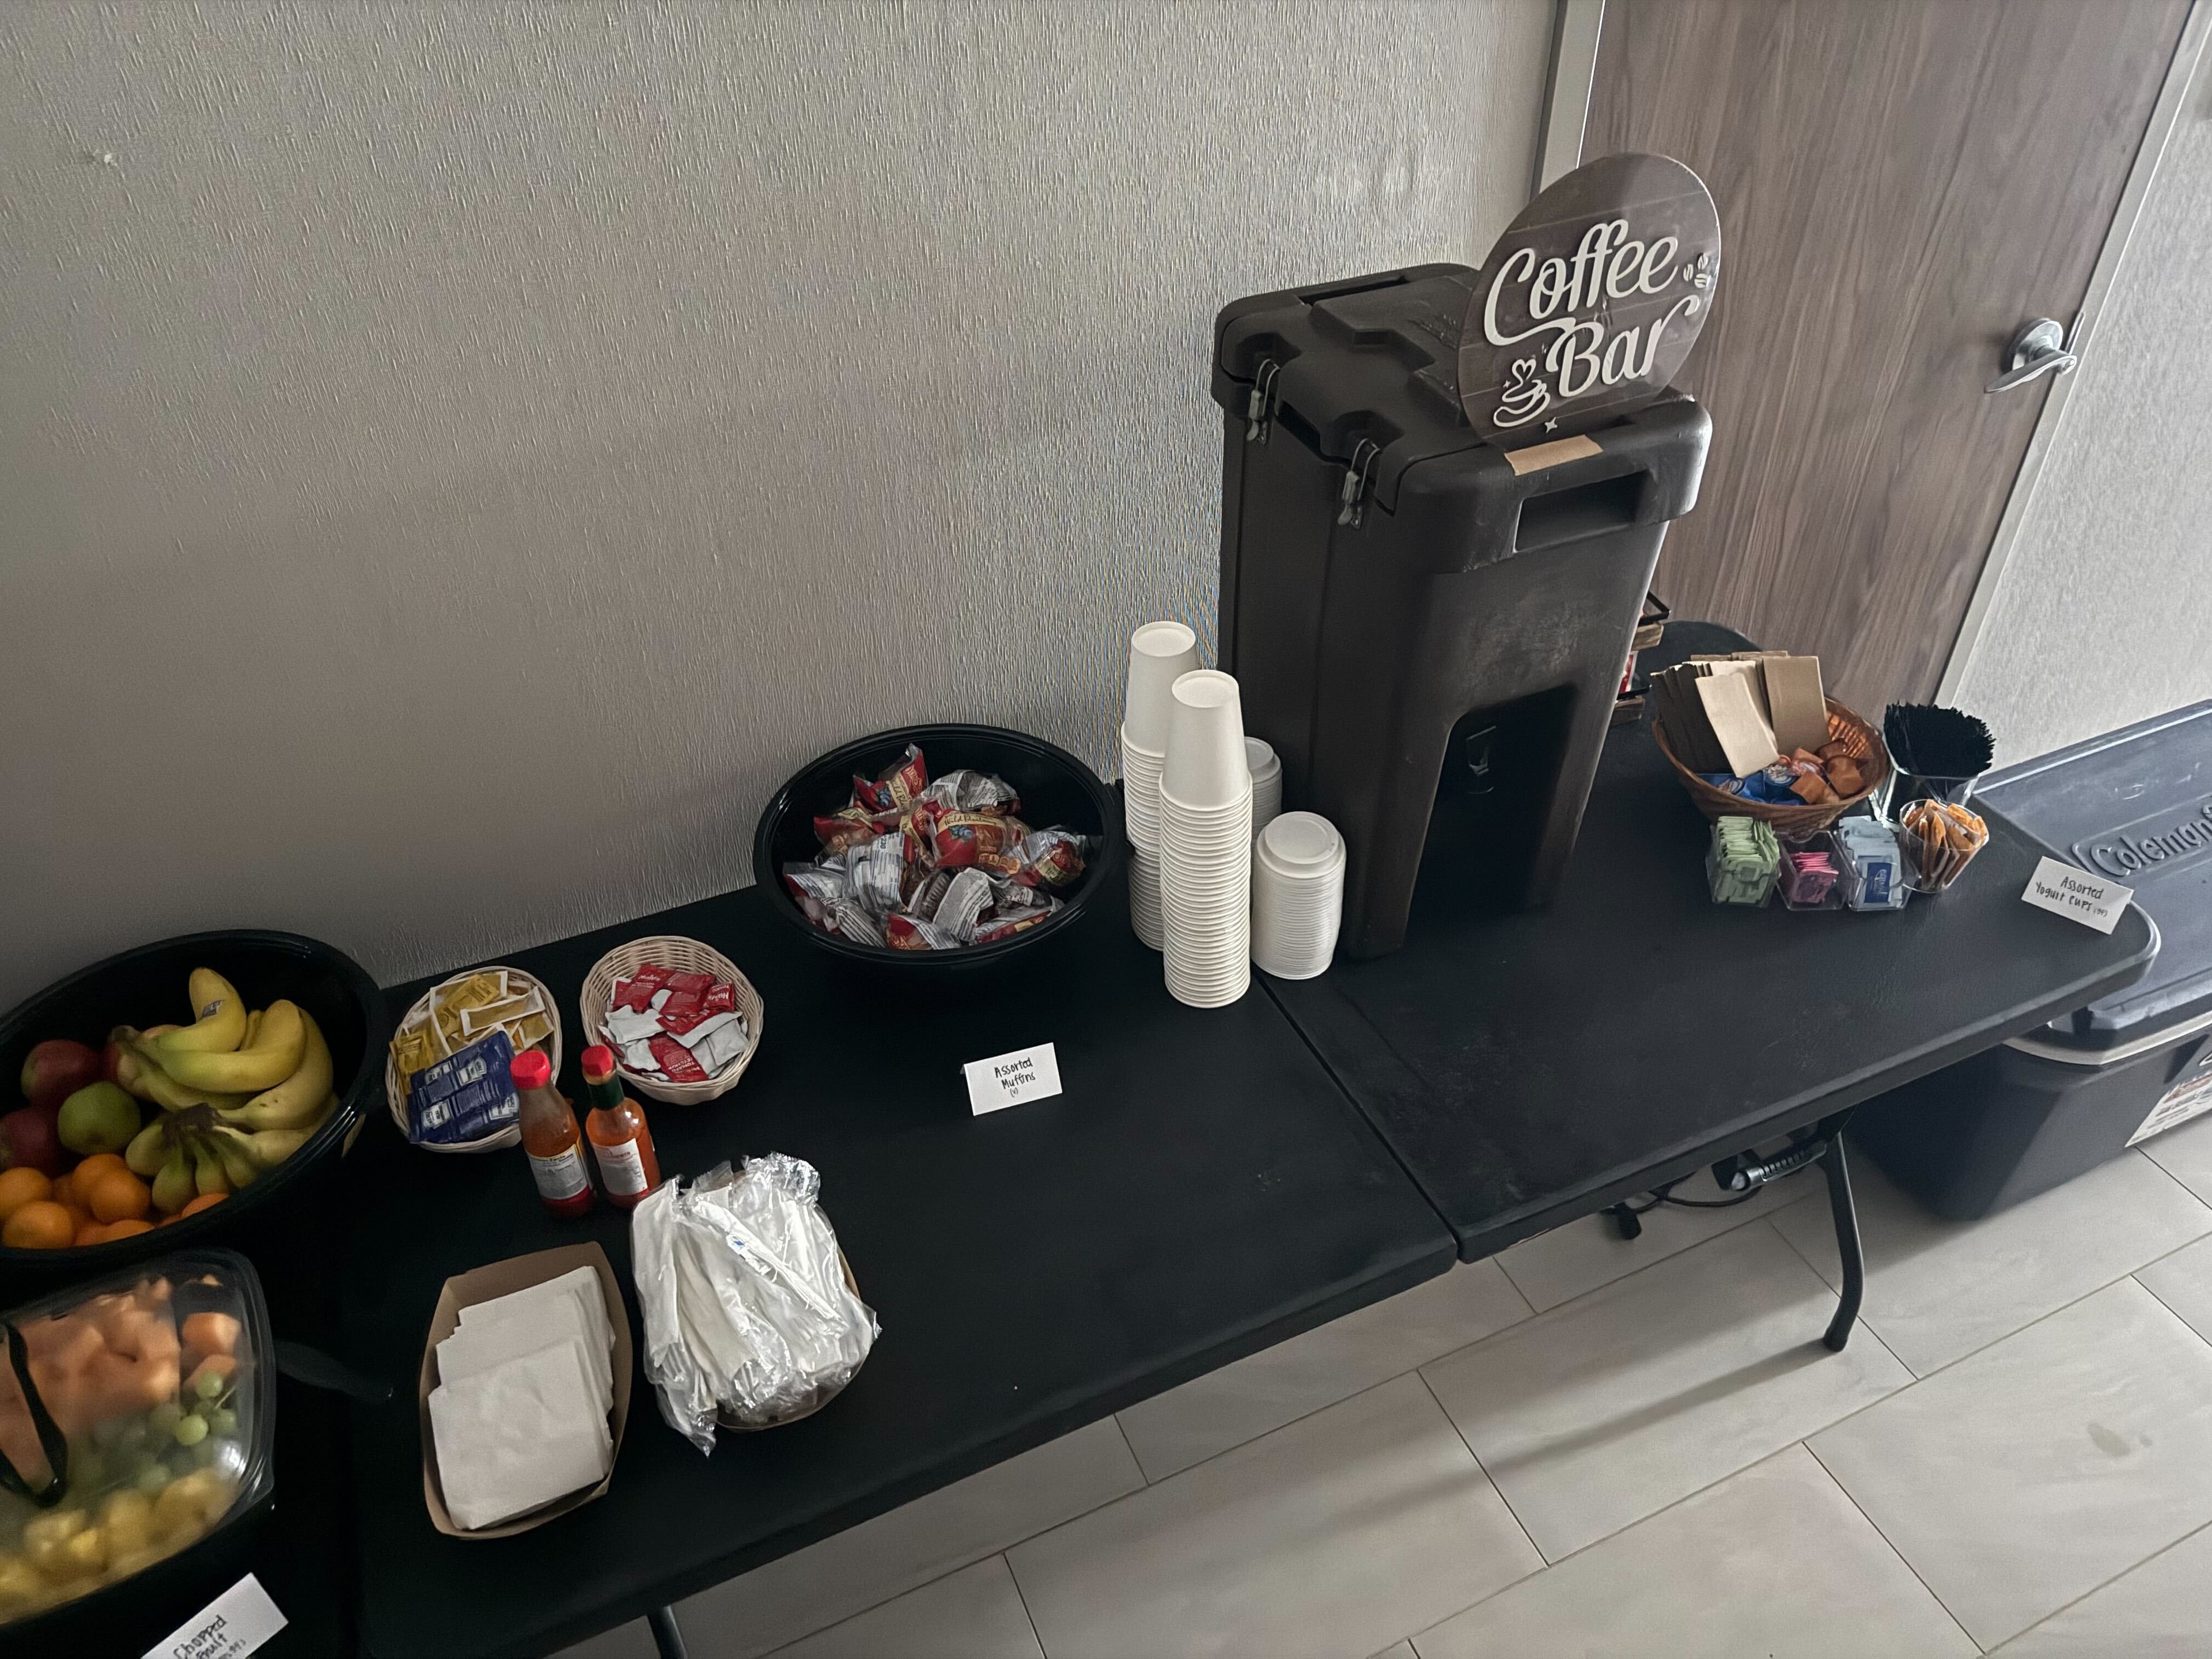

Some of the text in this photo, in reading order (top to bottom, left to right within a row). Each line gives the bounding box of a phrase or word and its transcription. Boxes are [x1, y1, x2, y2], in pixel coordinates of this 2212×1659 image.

[1484, 219, 1679, 346] Coffee
[1546, 294, 1700, 397] Bar
[2090, 820, 2212, 877] Coleman
[2036, 881, 2065, 902] Yogurt
[2060, 876, 2104, 900] Assorted
[994, 1056, 1033, 1078] Assorted
[1001, 1071, 1036, 1089] Muffins
